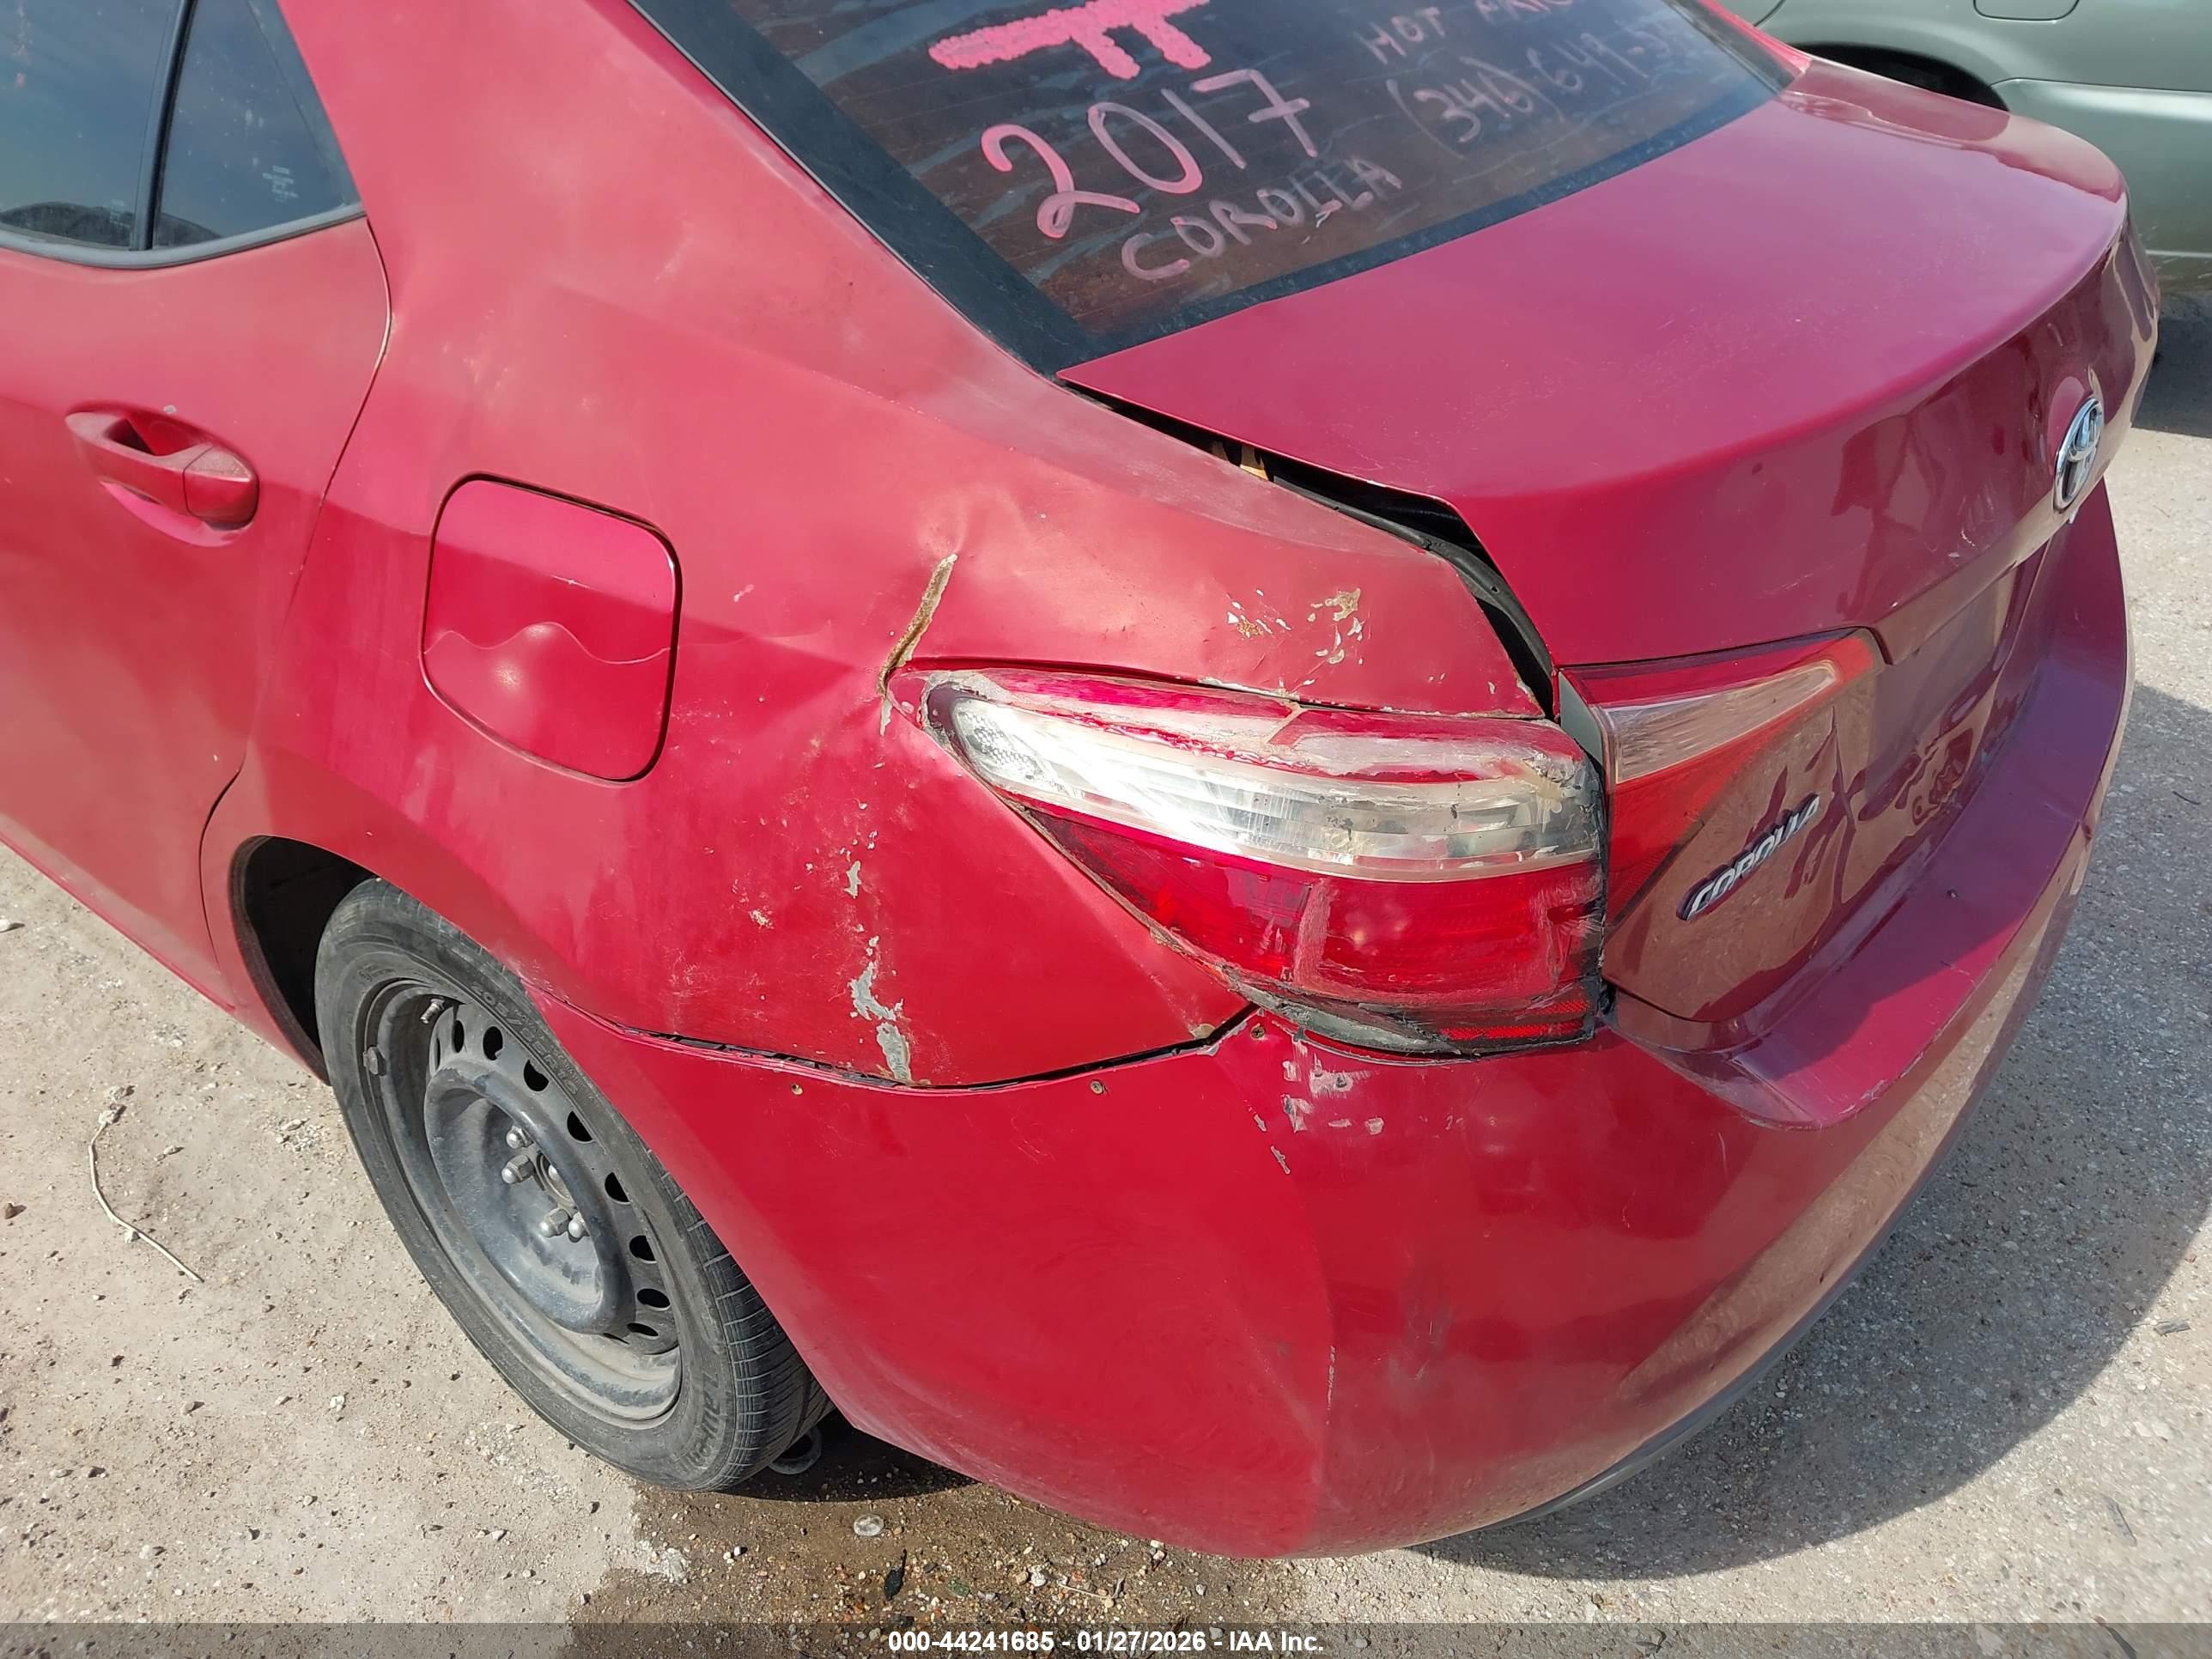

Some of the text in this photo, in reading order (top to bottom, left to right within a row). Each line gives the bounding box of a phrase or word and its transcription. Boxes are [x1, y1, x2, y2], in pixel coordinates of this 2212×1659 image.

[1352, 7, 1446, 64] HOT
[981, 69, 1317, 238] 2017
[1121, 157, 1402, 281] COROLLA
[1676, 792, 1820, 921] COROLLA
